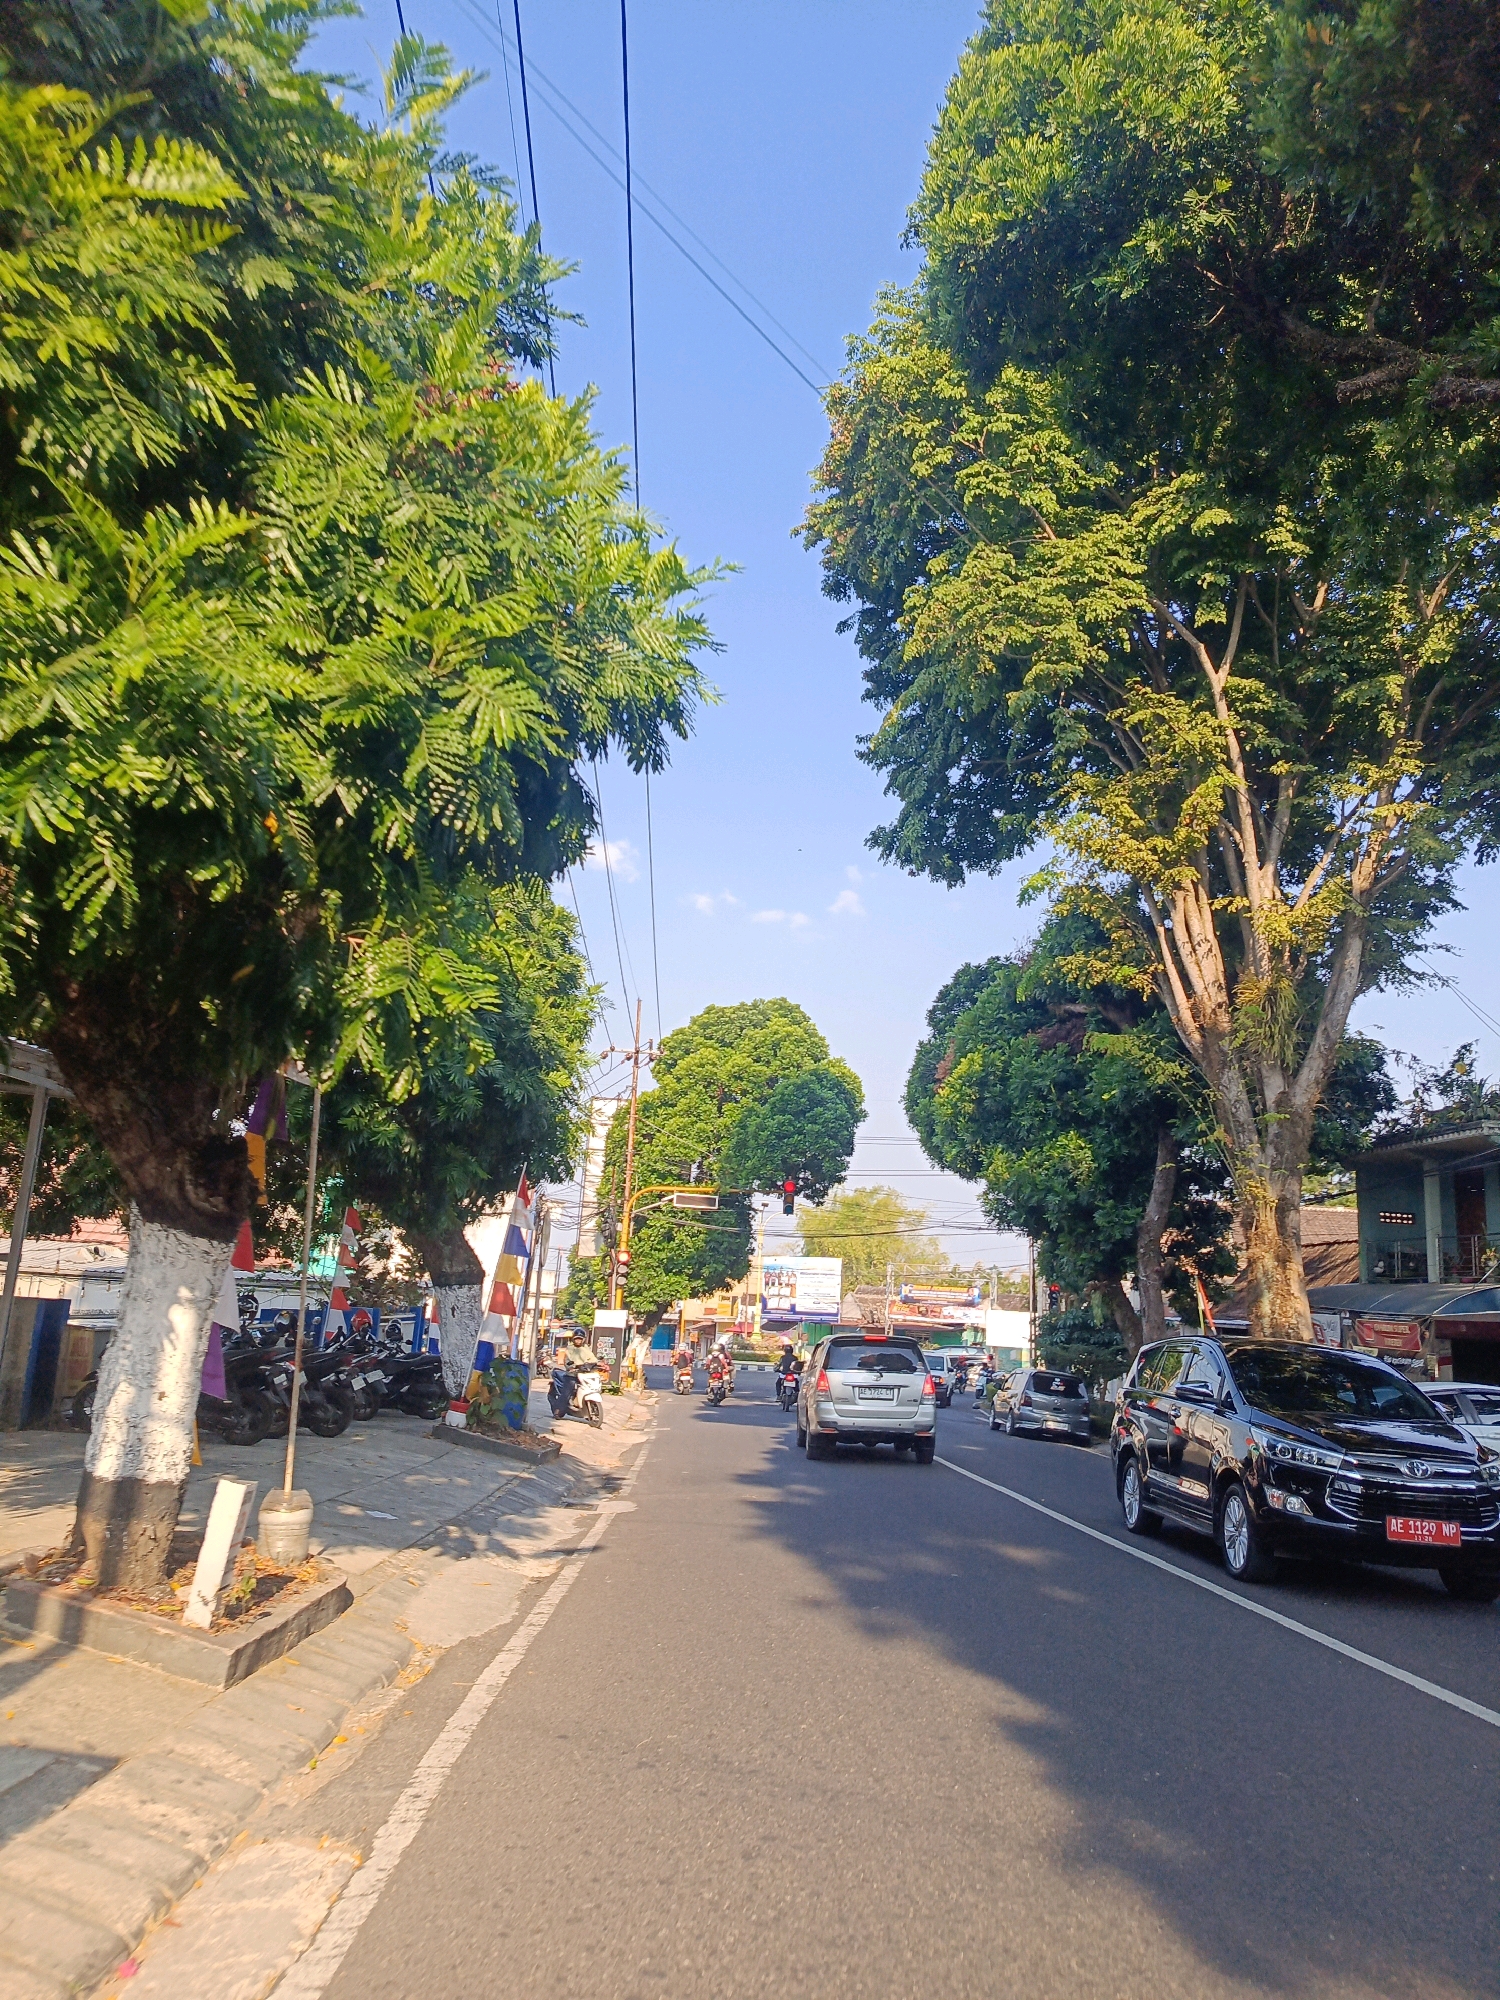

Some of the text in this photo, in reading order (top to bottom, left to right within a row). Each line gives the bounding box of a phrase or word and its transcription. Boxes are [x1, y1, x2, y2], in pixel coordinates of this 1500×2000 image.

[1391, 1519, 1456, 1537] AE 1129 NP
